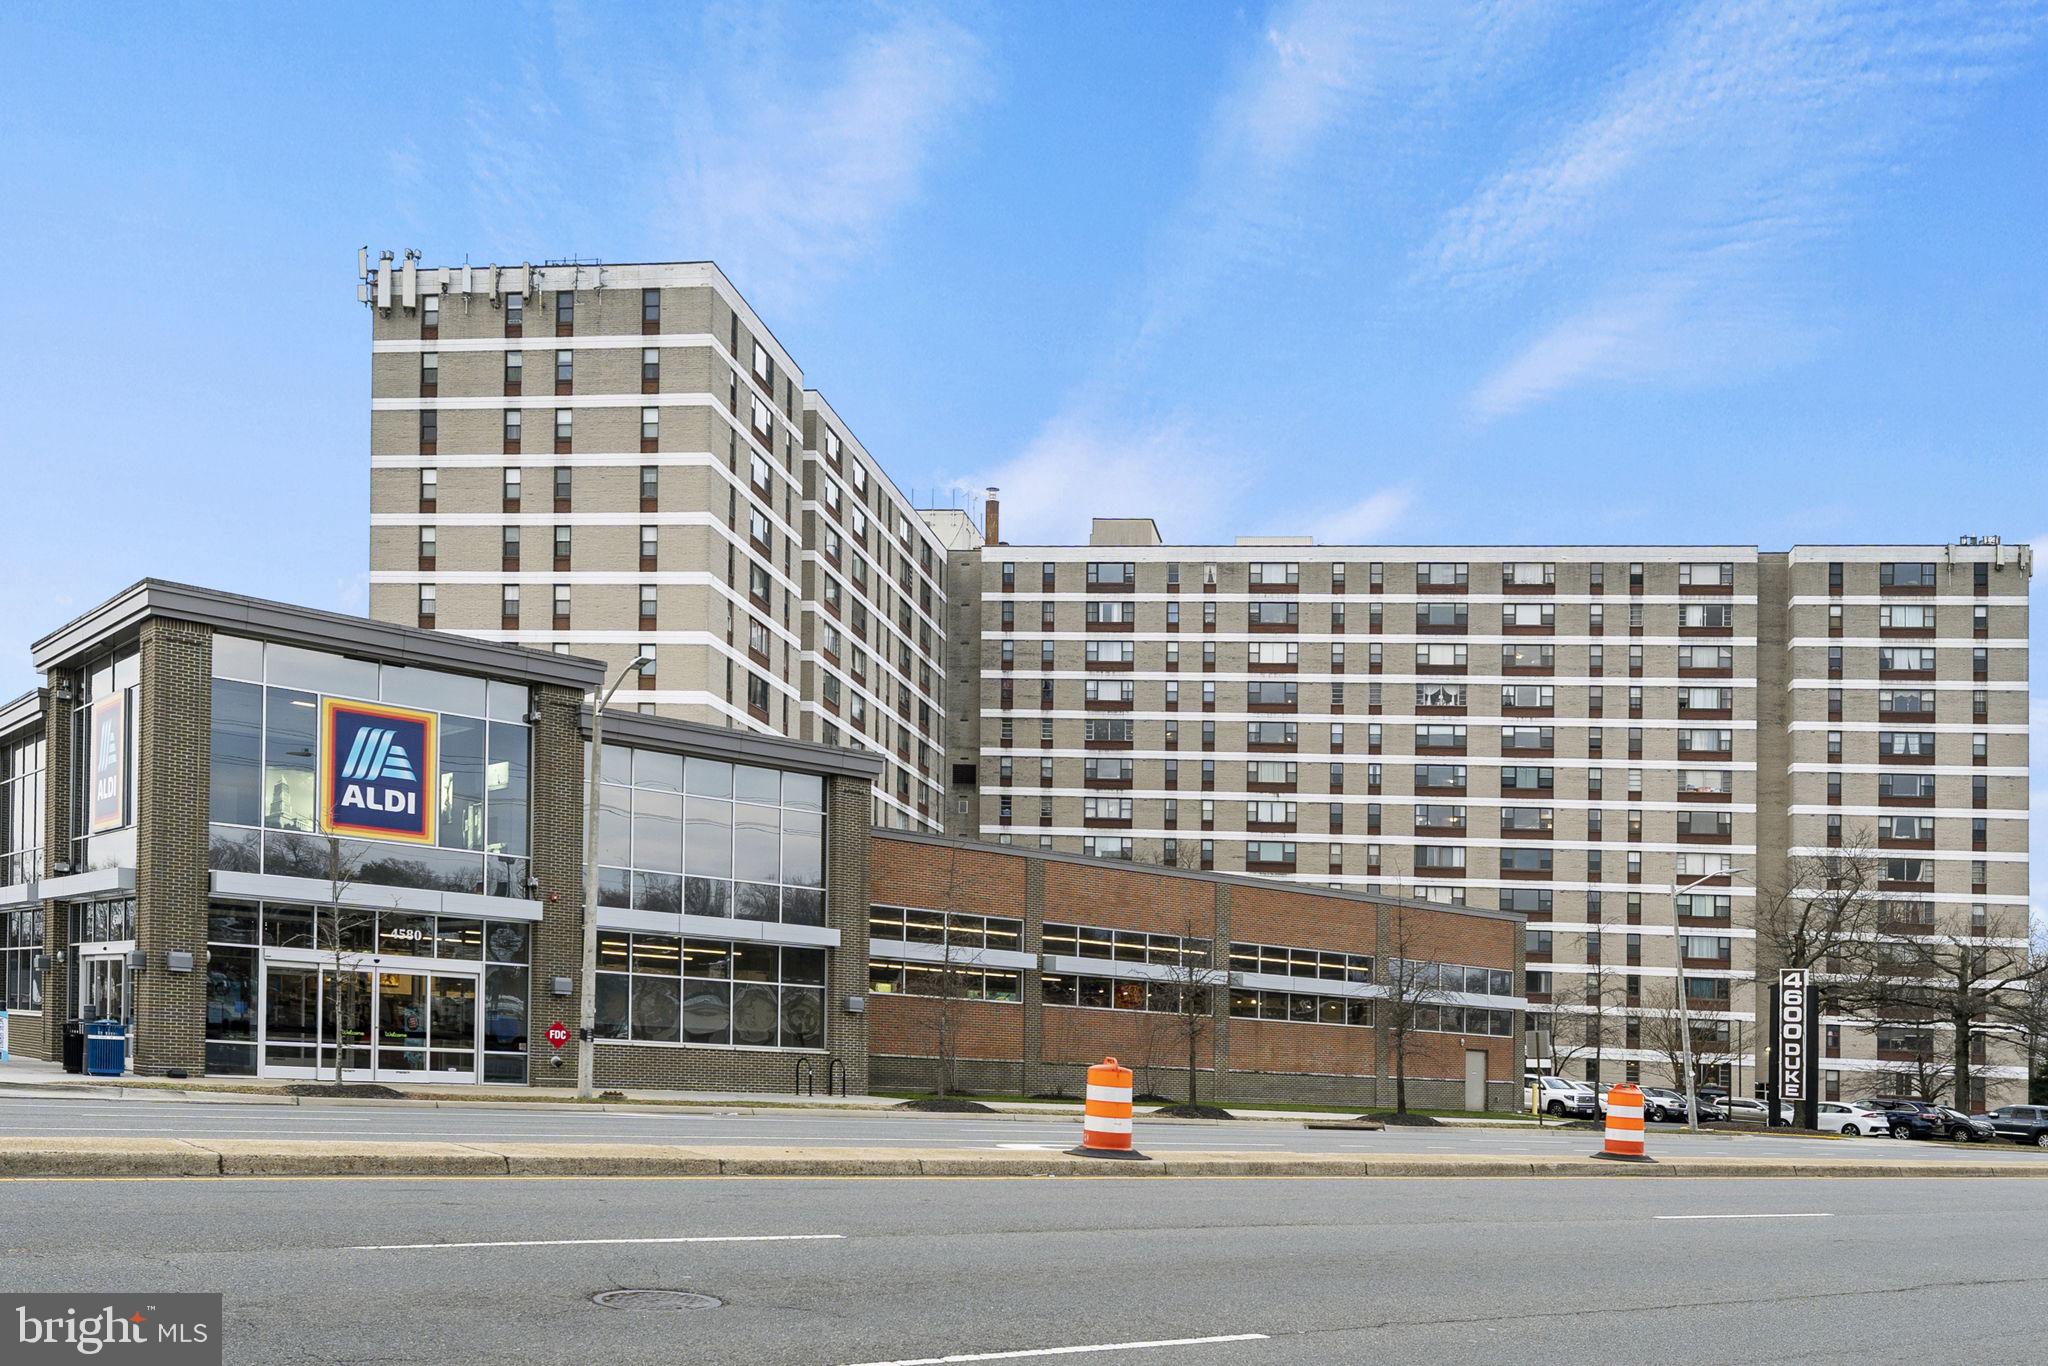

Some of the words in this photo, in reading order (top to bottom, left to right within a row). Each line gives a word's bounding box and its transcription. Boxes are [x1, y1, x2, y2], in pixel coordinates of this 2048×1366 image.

[97, 775, 117, 801] ALDI
[341, 784, 416, 815] ALDI
[391, 928, 422, 941] 4580
[1783, 972, 1803, 1039] 4600
[549, 1029, 567, 1040] FDC
[1784, 1043, 1801, 1097] DUKE
